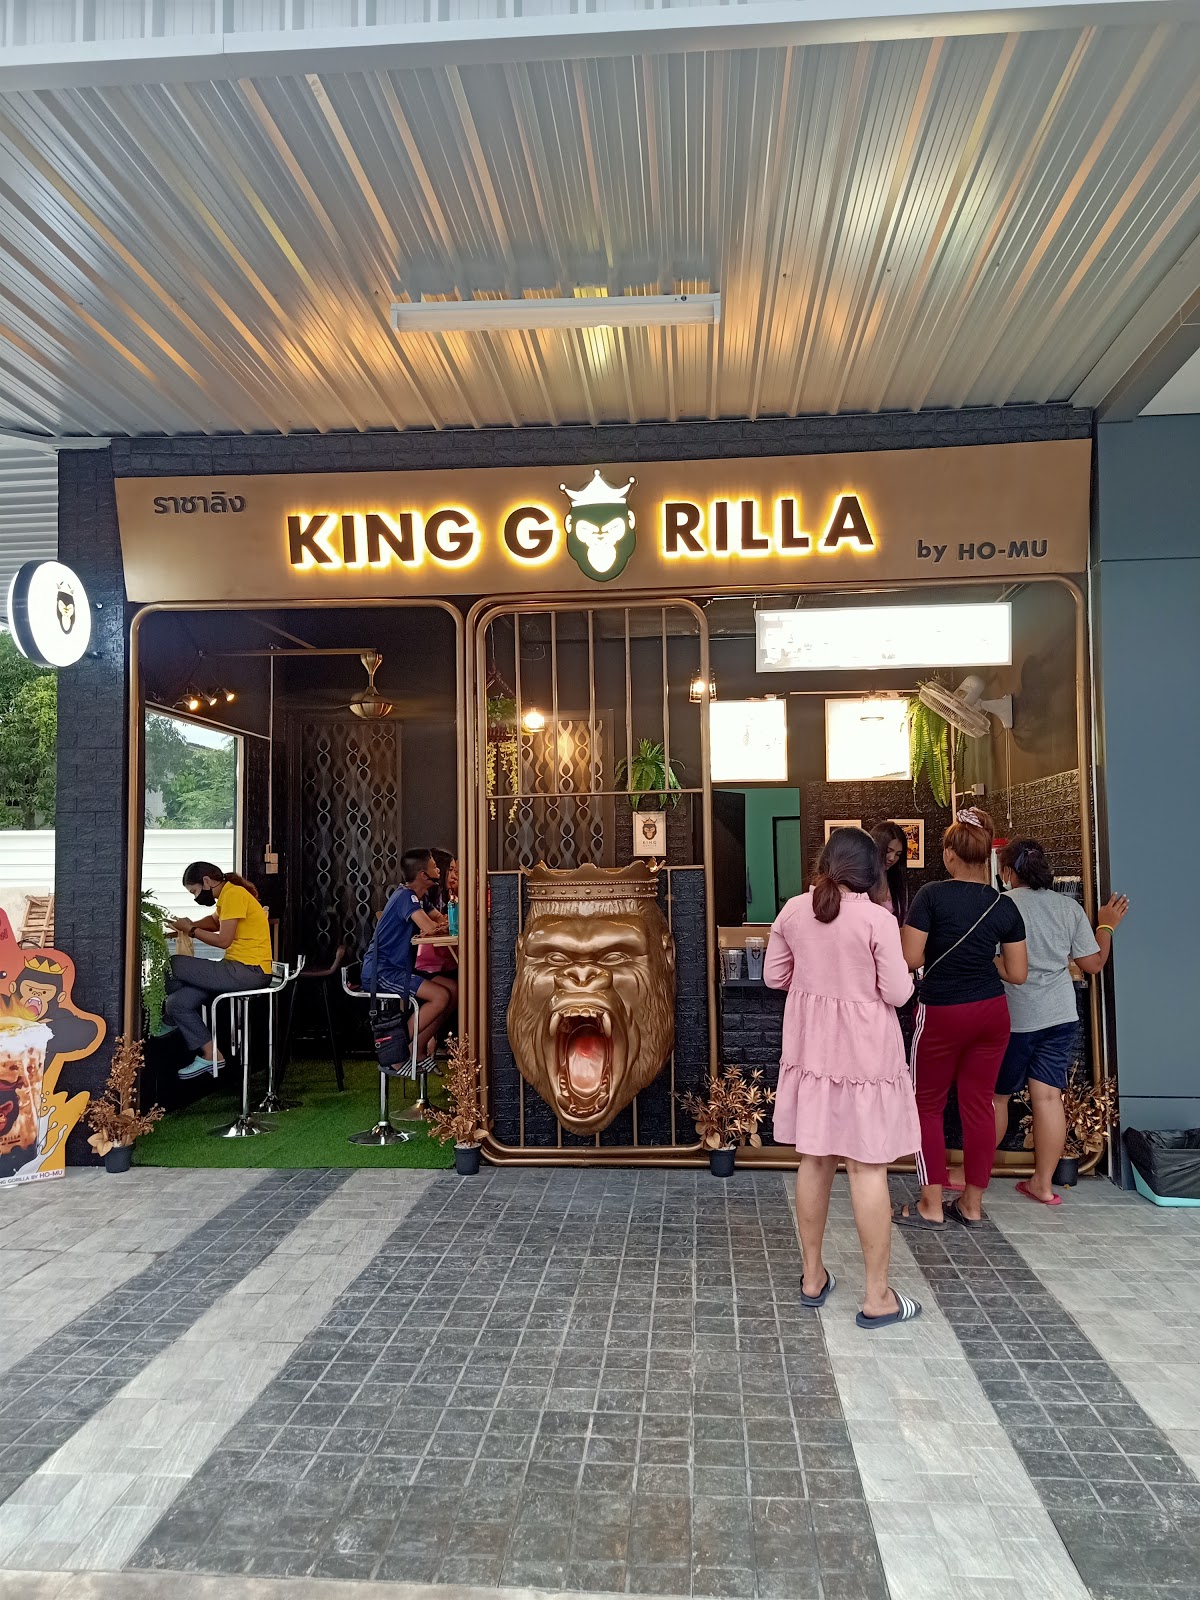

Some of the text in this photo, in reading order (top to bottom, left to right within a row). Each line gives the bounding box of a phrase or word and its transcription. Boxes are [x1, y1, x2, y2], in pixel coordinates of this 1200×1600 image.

[154, 491, 246, 514] ราชาลิง
[287, 508, 475, 565] KING
[917, 539, 1048, 563] by HO-MU
[39, 1169, 63, 1179] HO-MU
